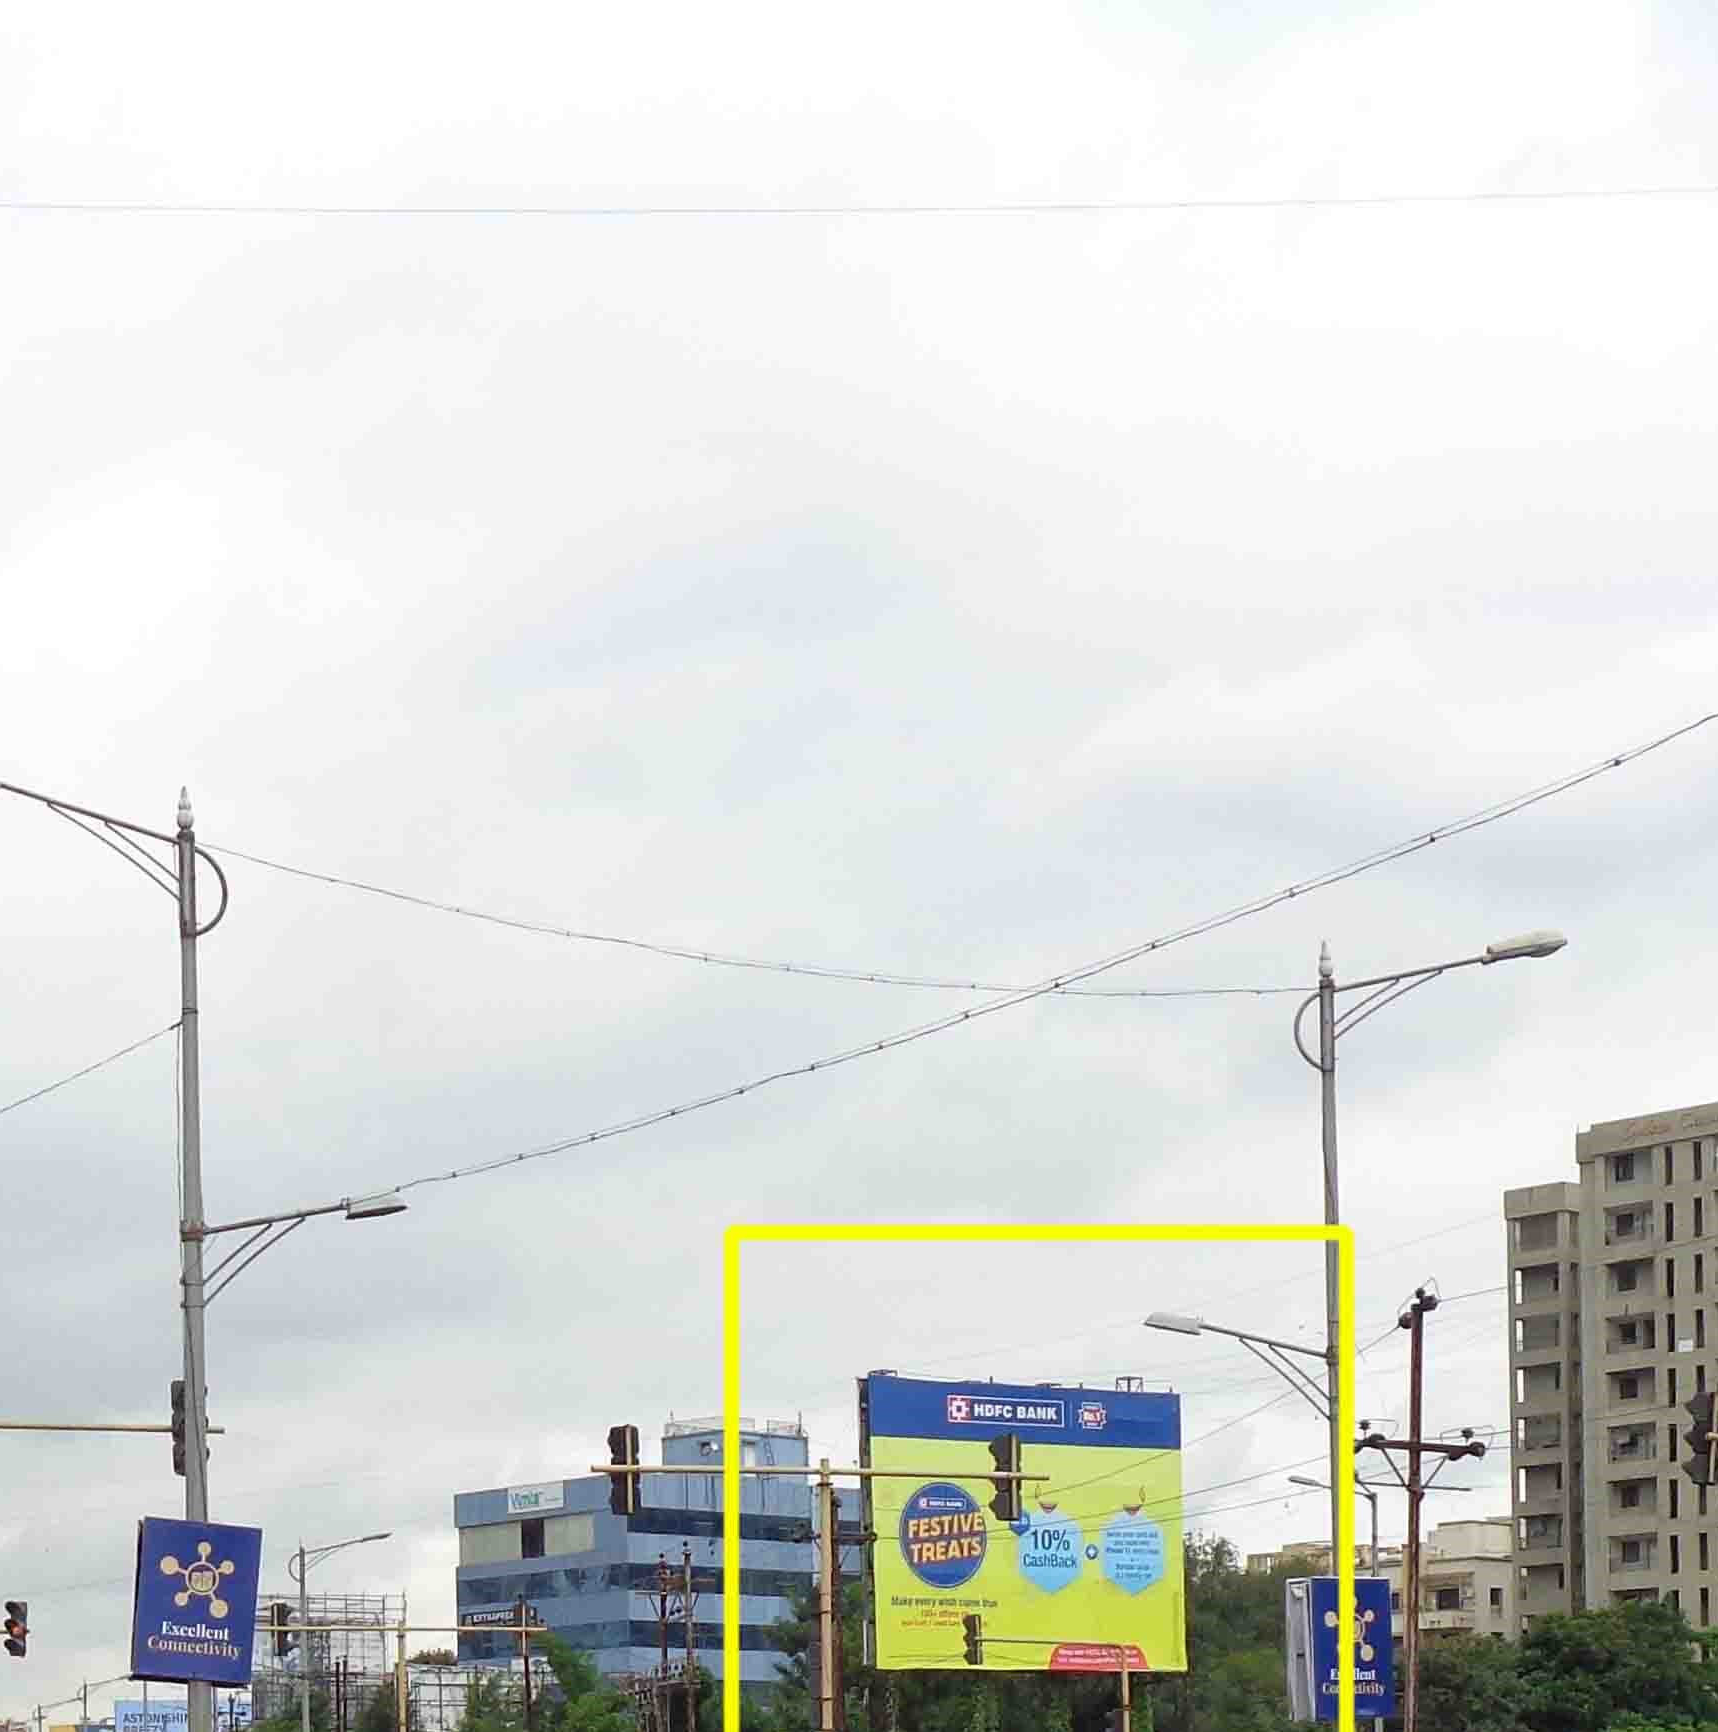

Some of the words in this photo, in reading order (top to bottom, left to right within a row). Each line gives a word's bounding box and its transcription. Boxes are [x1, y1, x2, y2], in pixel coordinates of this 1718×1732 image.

[974, 1403, 1013, 1418] HDFC
[1016, 1405, 1058, 1420] BANK
[908, 1512, 984, 1539] FESTIVE
[1032, 1529, 1071, 1550] 10%
[910, 1537, 982, 1563] TREATS
[1023, 1553, 1077, 1569] CashBack
[162, 1621, 230, 1641] Excellent
[147, 1635, 241, 1660] Connectivity
[1330, 1667, 1376, 1681] Elent
[1322, 1682, 1386, 1697] Coctivity
[122, 1711, 188, 1724] ASTONISHIN
